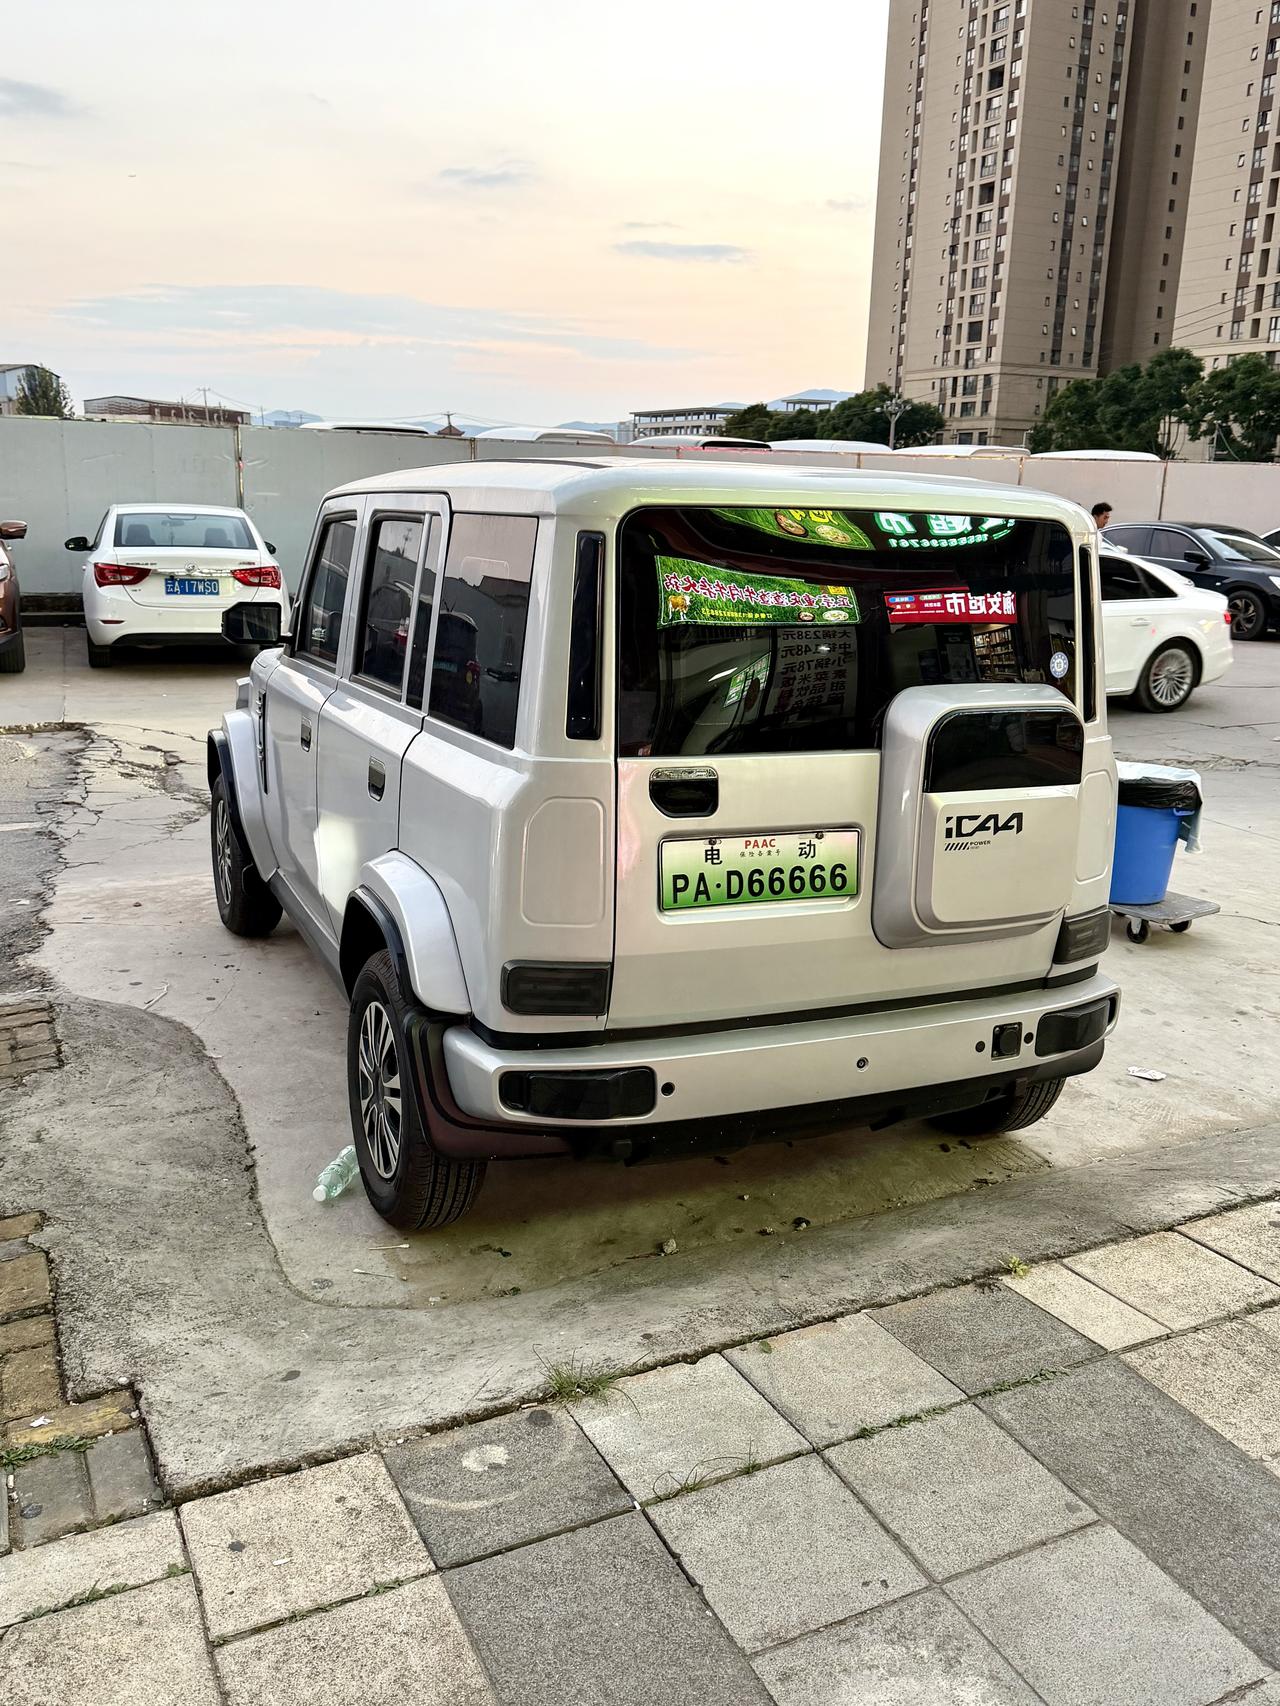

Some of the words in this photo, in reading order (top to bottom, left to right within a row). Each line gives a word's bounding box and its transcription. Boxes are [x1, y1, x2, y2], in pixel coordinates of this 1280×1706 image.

[705, 846, 723, 865] 电
[798, 840, 816, 859] 动
[744, 838, 776, 849] PAAC
